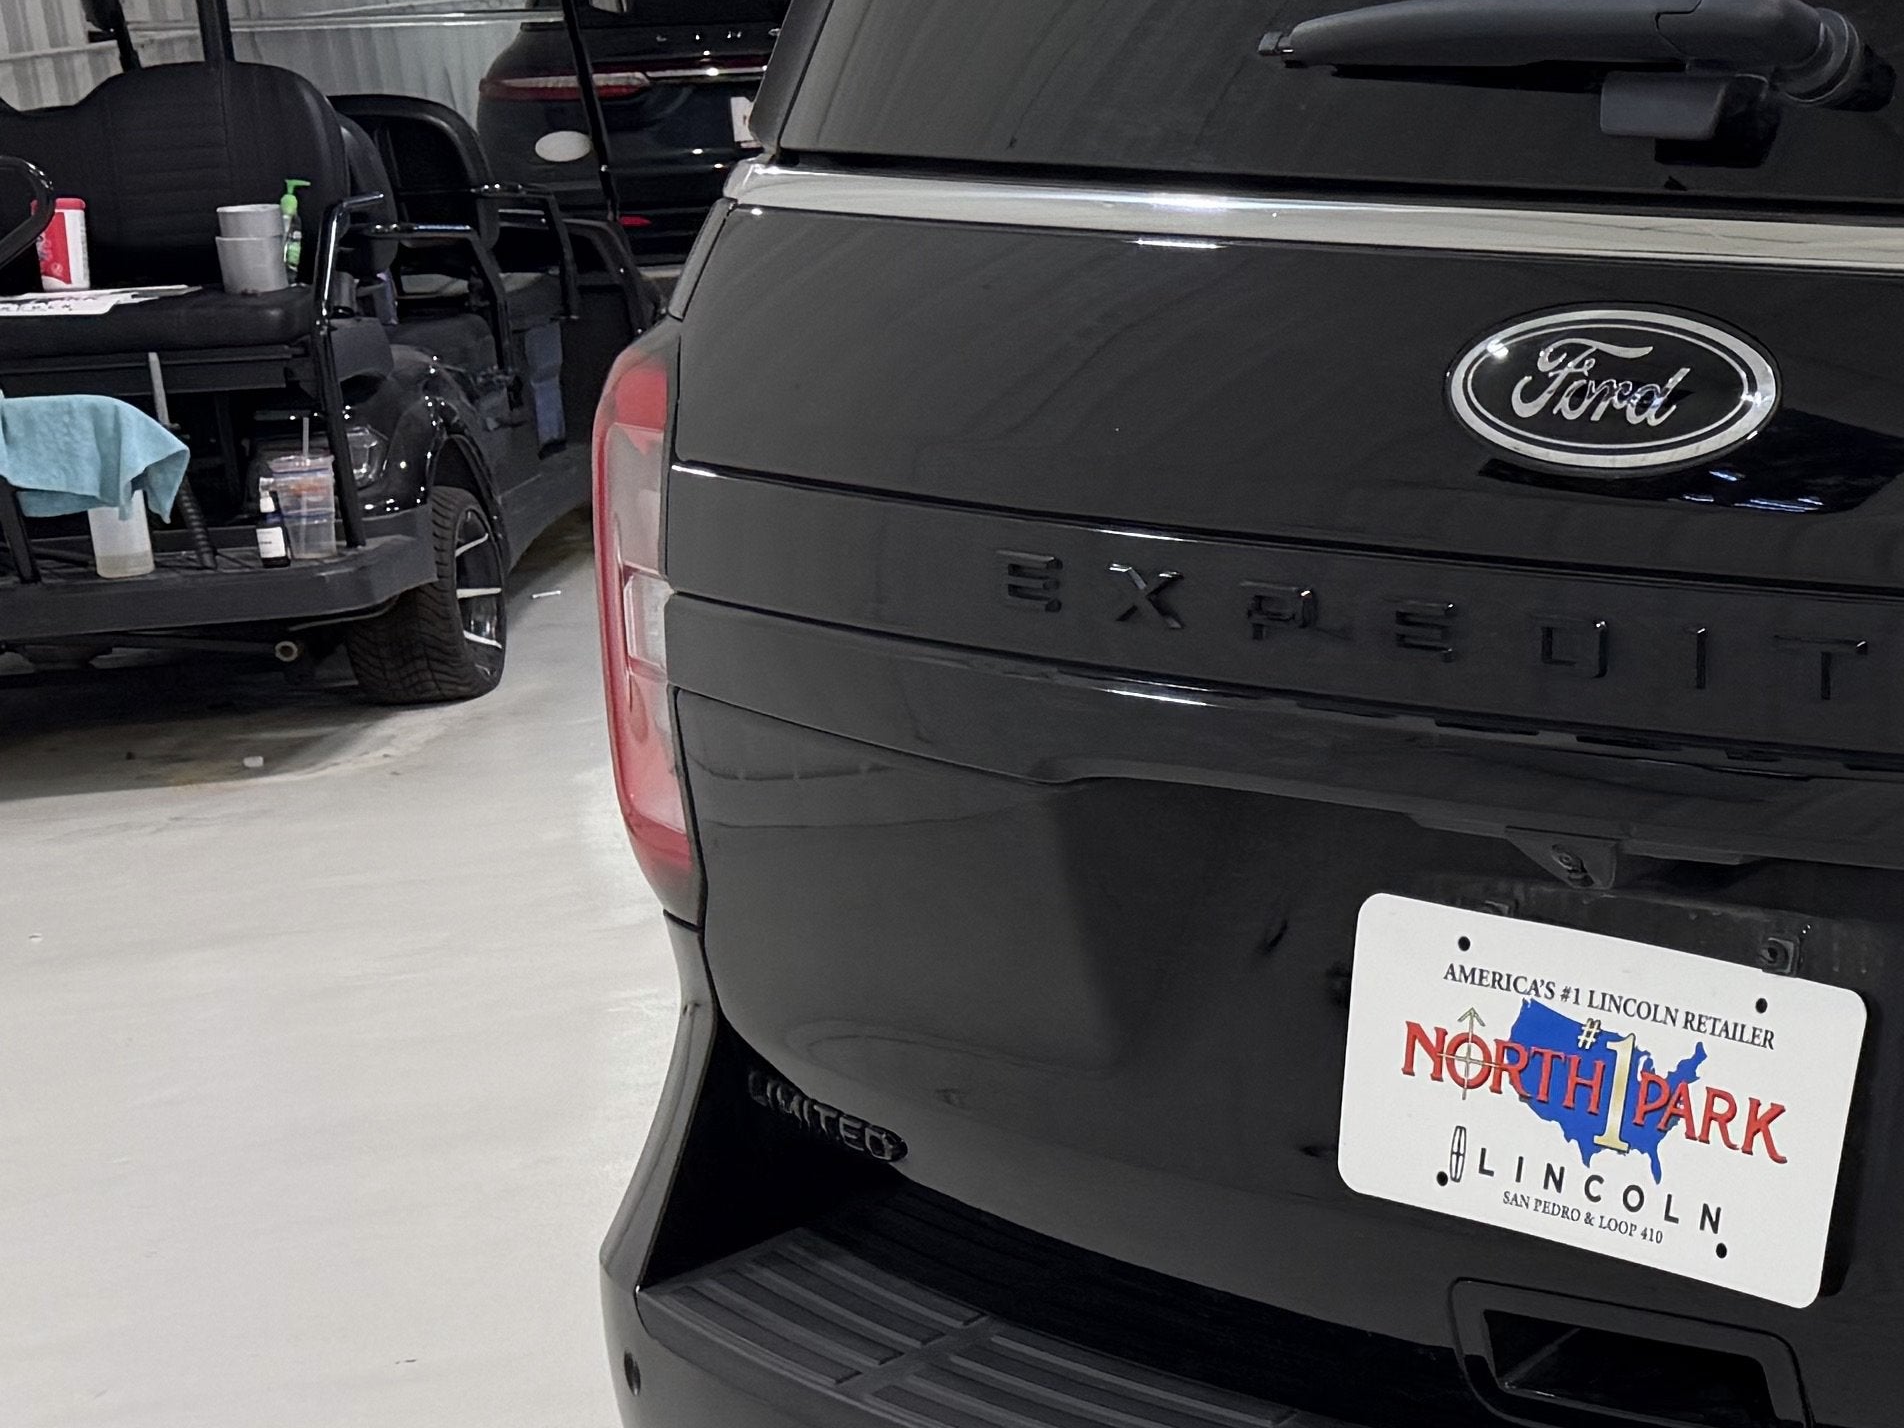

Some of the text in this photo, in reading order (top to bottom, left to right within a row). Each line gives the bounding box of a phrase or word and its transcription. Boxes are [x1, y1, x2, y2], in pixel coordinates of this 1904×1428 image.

[1511, 337, 1691, 427] Ford
[1443, 962, 1775, 1050] AMERICA'S #1 LINCOLN RETAILER
[1401, 1020, 1788, 1165] NORTH PARK
[1478, 1147, 1722, 1235] LINCOLN
[1502, 1190, 1663, 1245] SAN PEDRO & LOOP 410
